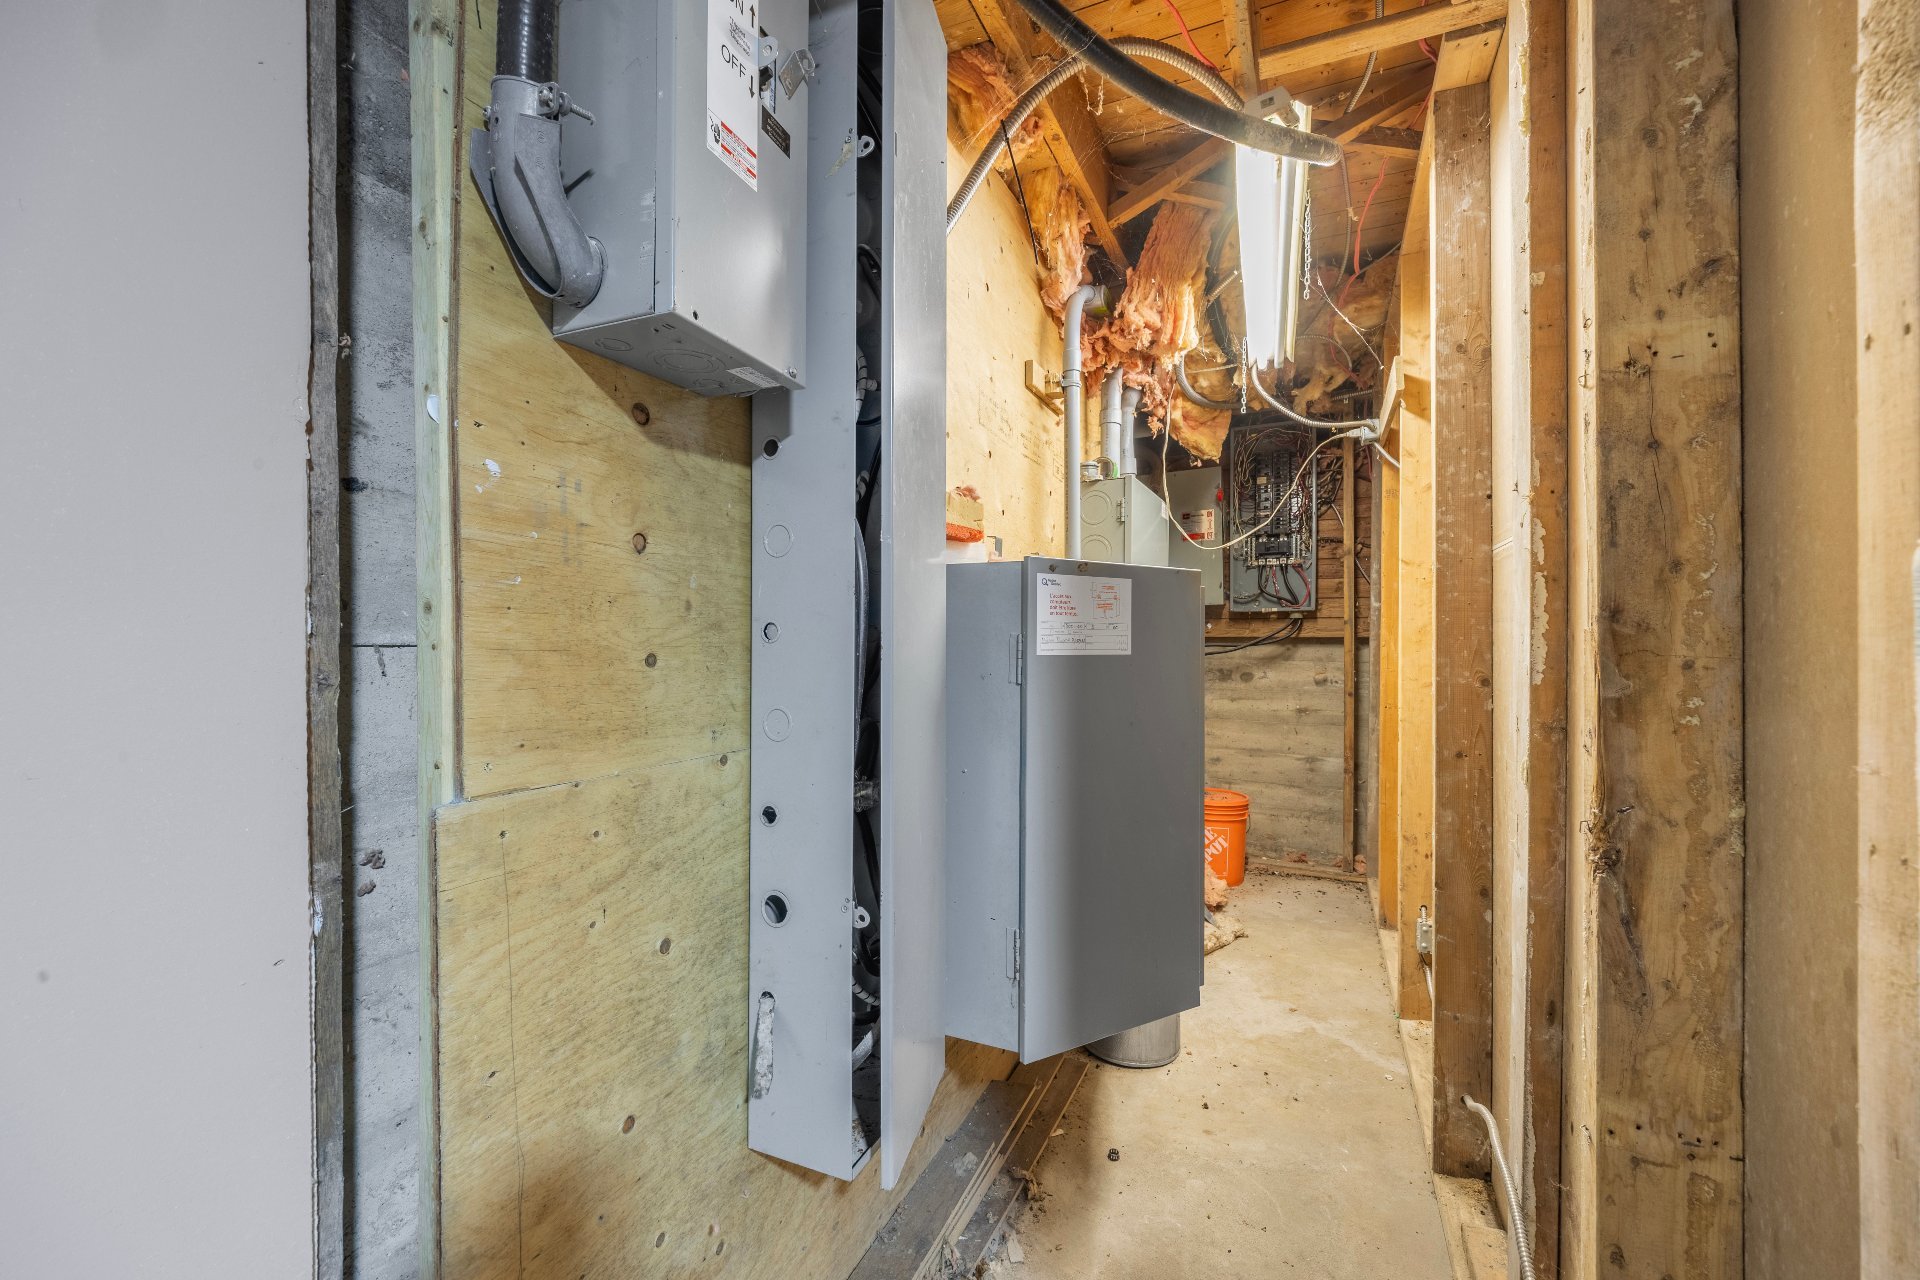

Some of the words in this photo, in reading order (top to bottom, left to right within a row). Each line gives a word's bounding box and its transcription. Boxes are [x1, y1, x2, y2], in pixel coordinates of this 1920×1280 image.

[730, 0, 744, 15] N
[721, 44, 747, 78] OFF
[1204, 835, 1228, 864] POT
